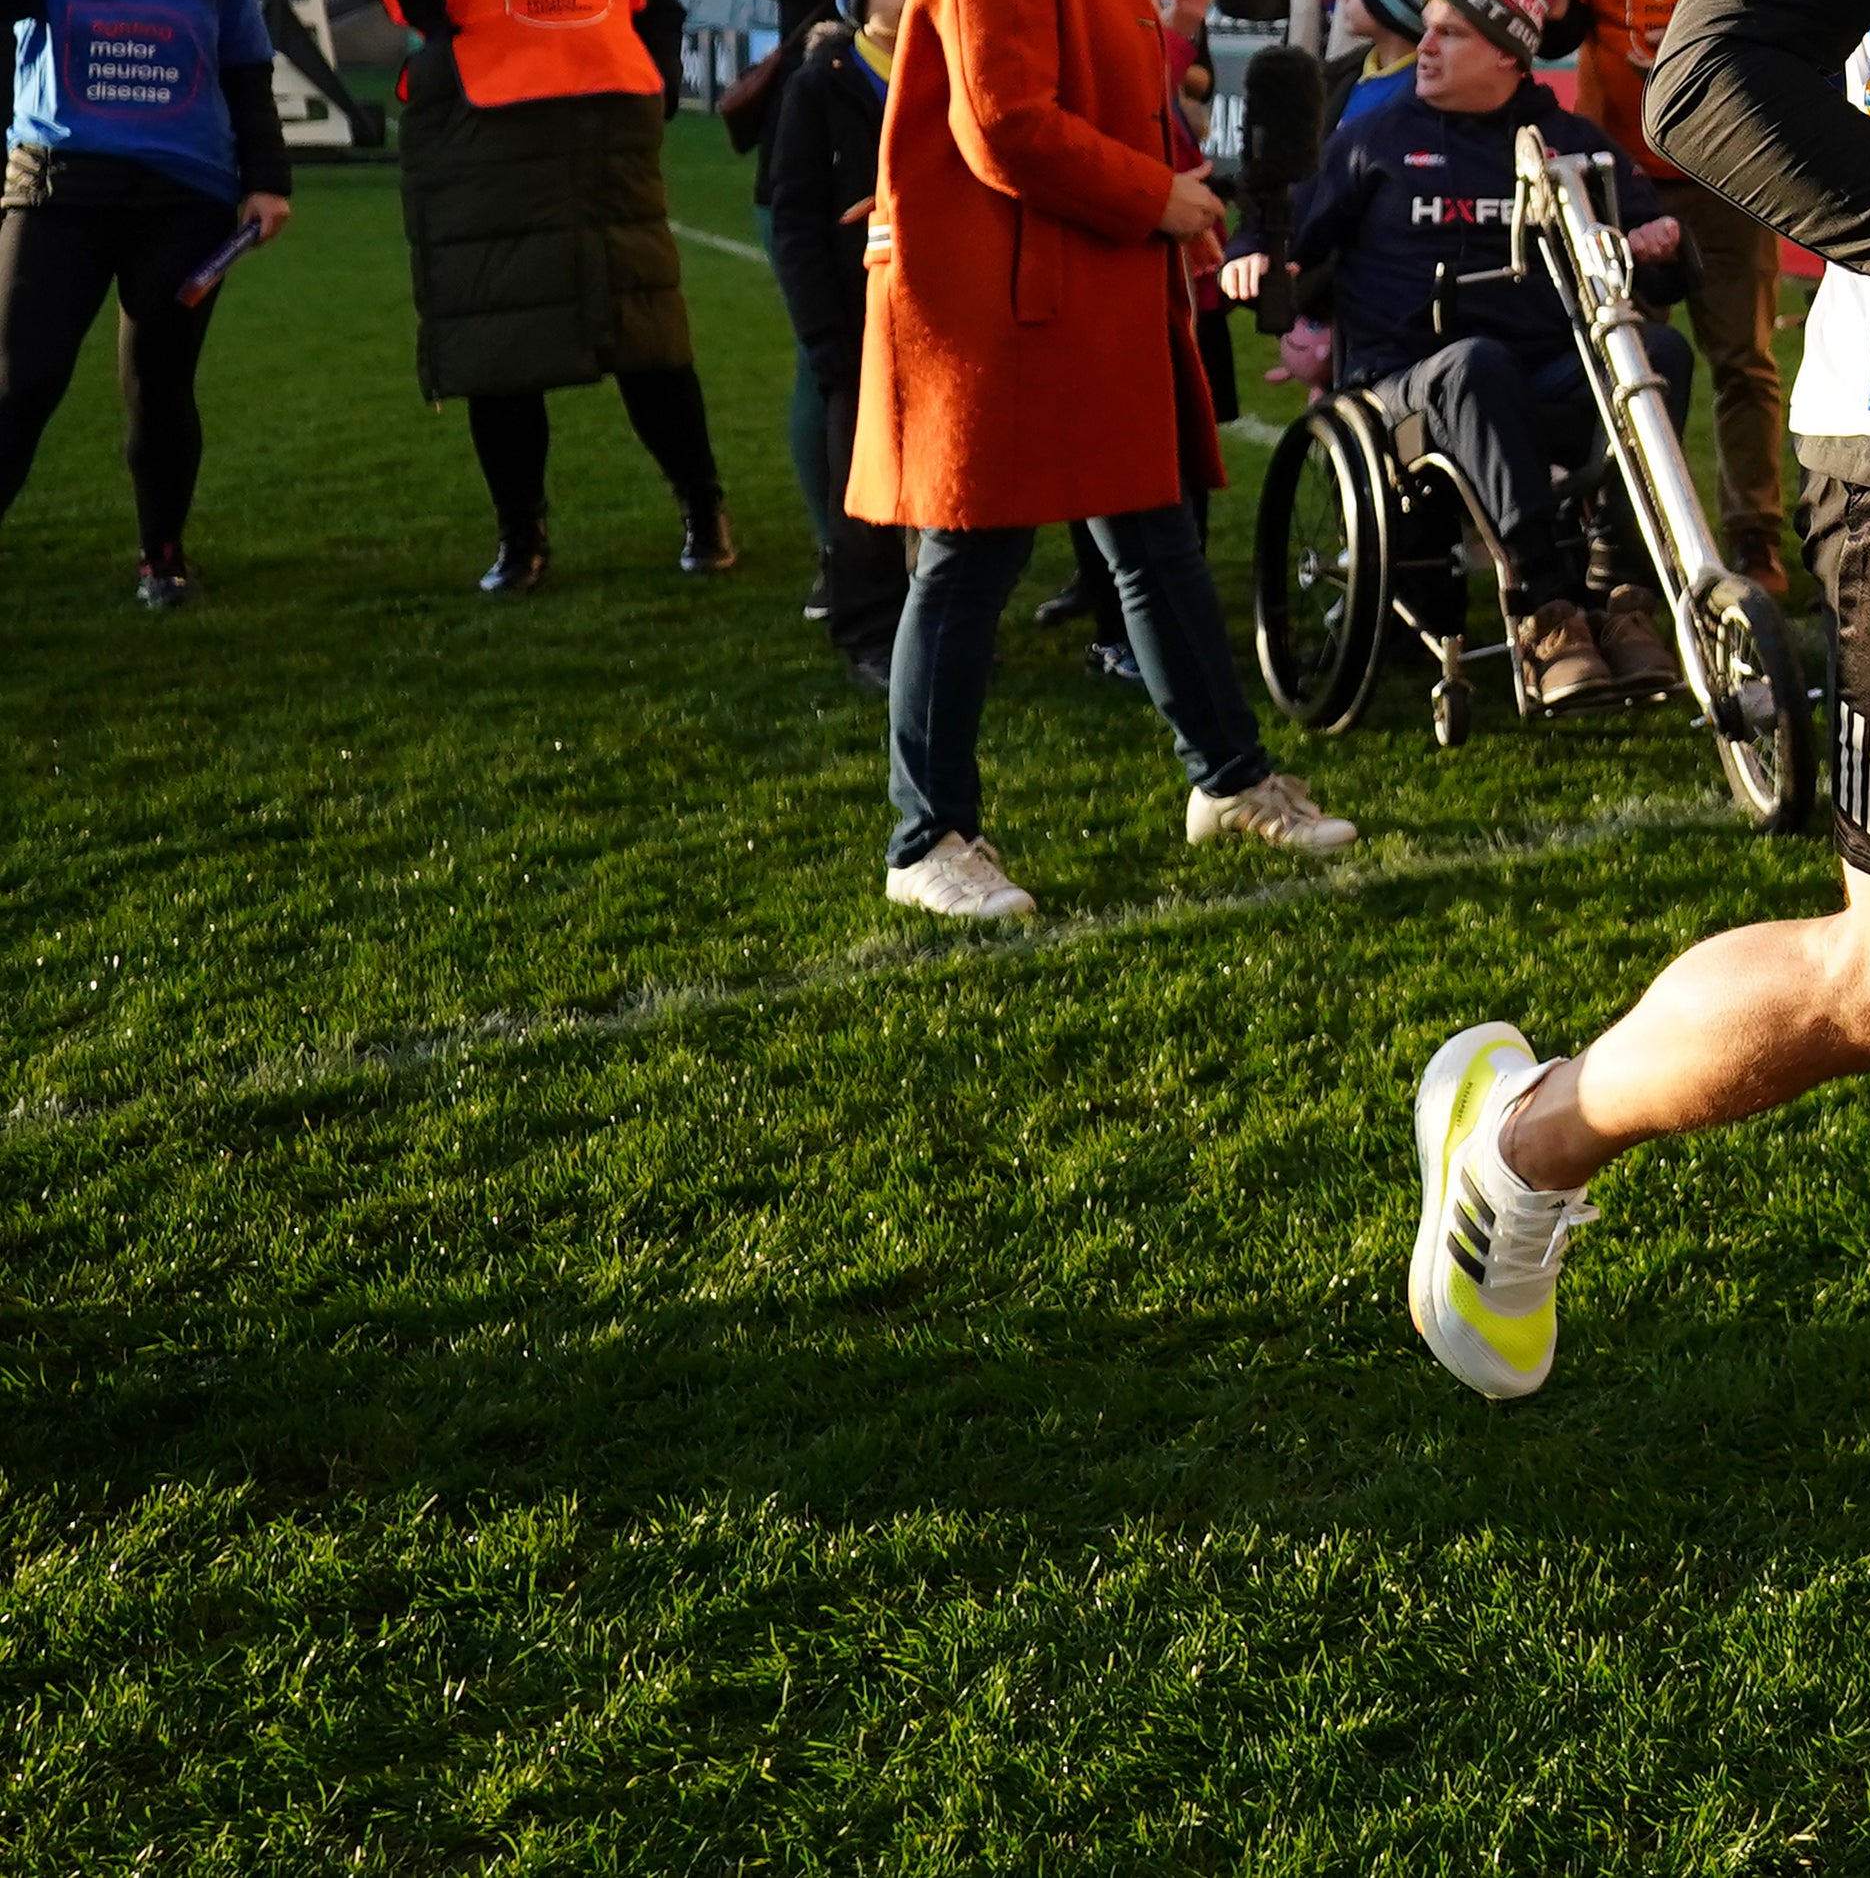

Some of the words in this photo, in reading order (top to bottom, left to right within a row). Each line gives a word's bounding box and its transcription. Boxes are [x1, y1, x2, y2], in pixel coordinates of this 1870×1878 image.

[90, 40, 156, 58] motor
[87, 61, 179, 83] neurone
[86, 81, 172, 104] disease
